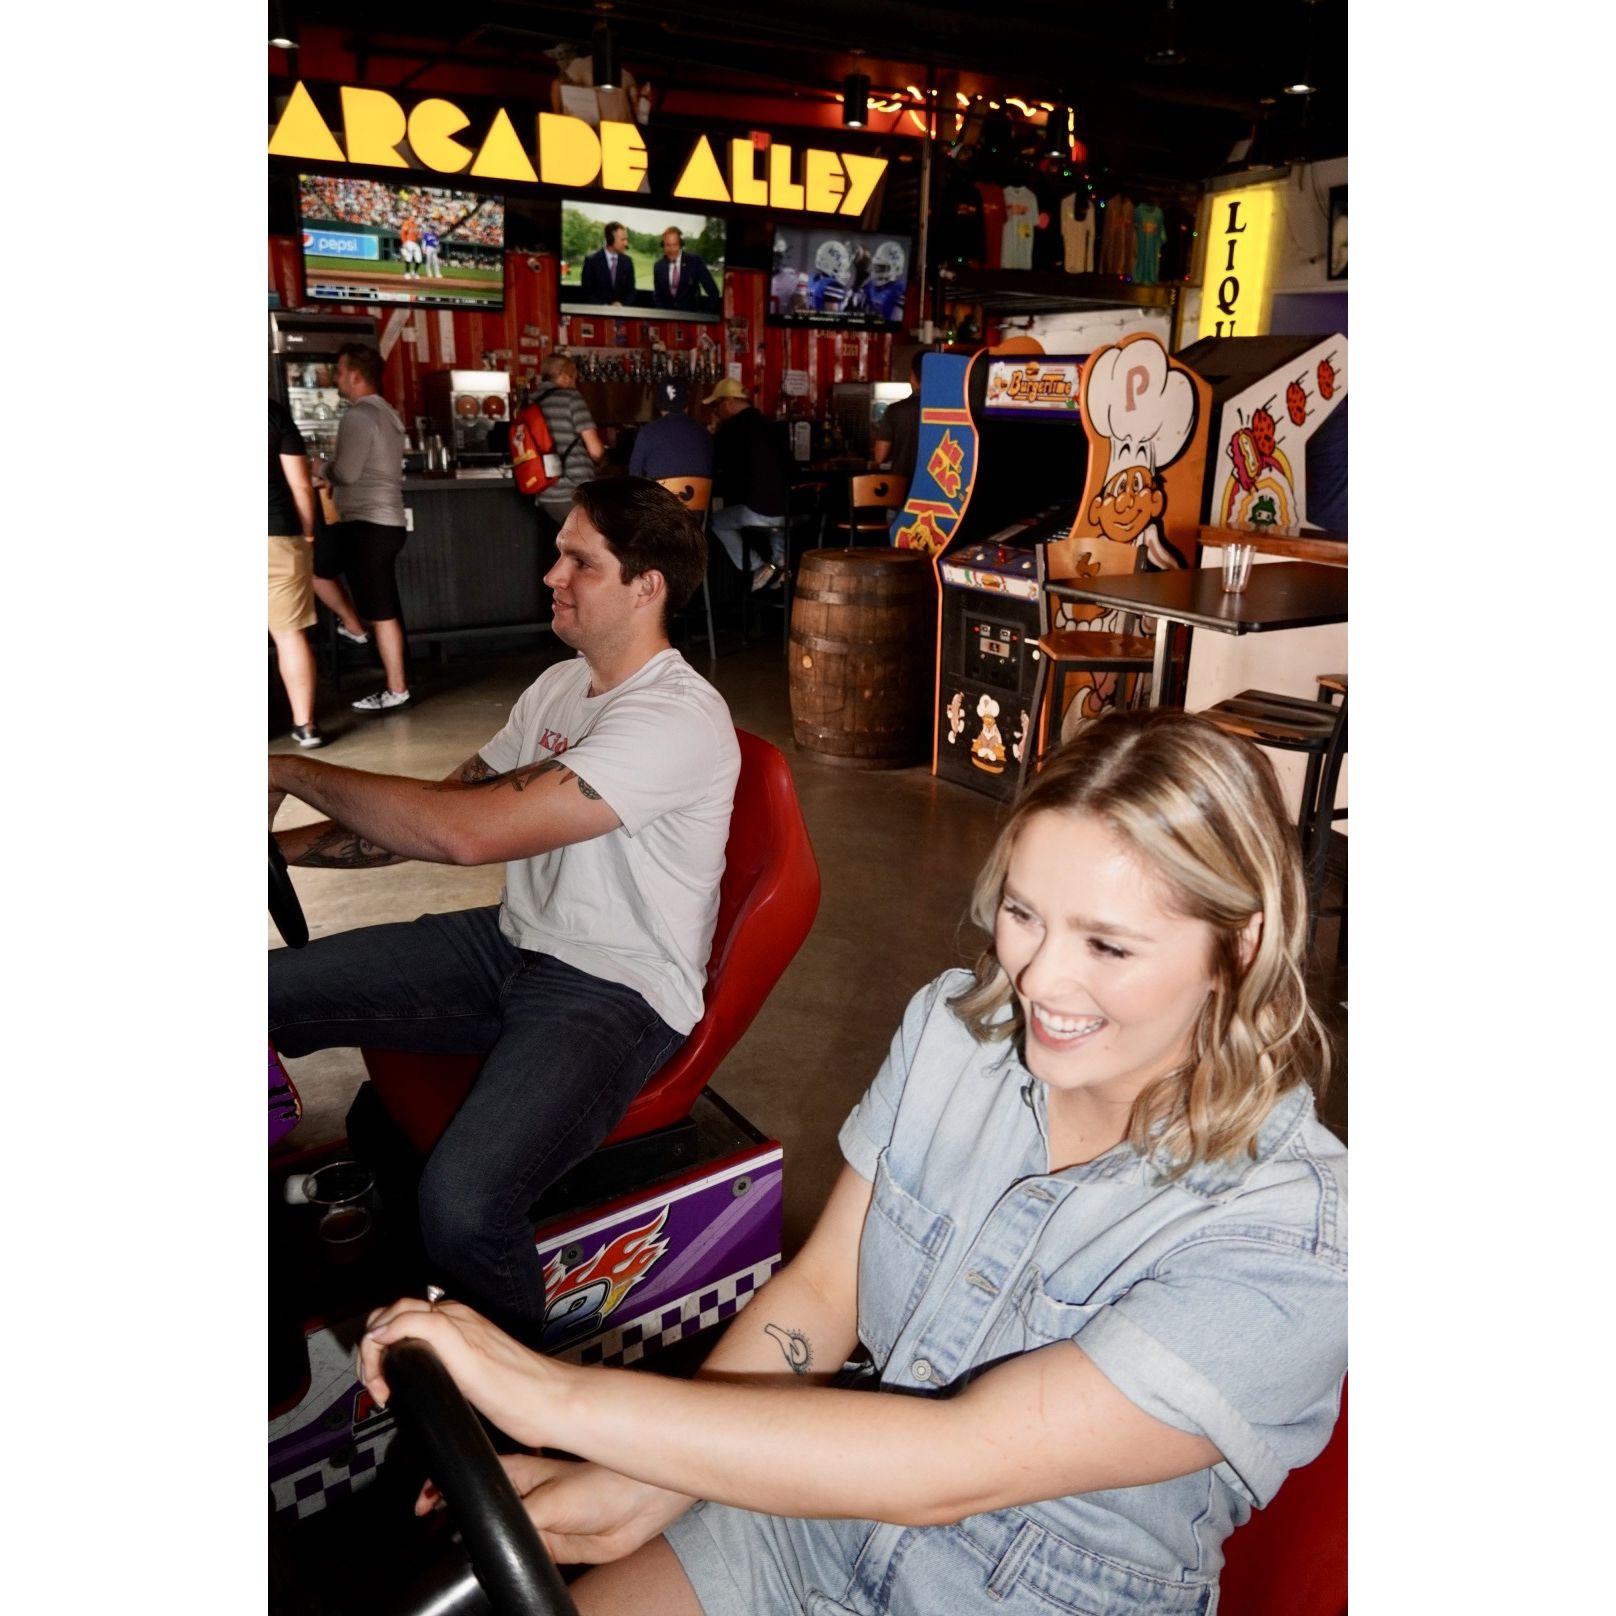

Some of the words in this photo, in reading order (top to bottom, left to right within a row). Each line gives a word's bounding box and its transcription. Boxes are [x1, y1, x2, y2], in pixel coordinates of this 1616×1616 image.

[268, 81, 648, 192] ARCADE
[673, 135, 888, 216] ALLEY
[319, 236, 358, 252] pepsi
[1125, 365, 1149, 412] P
